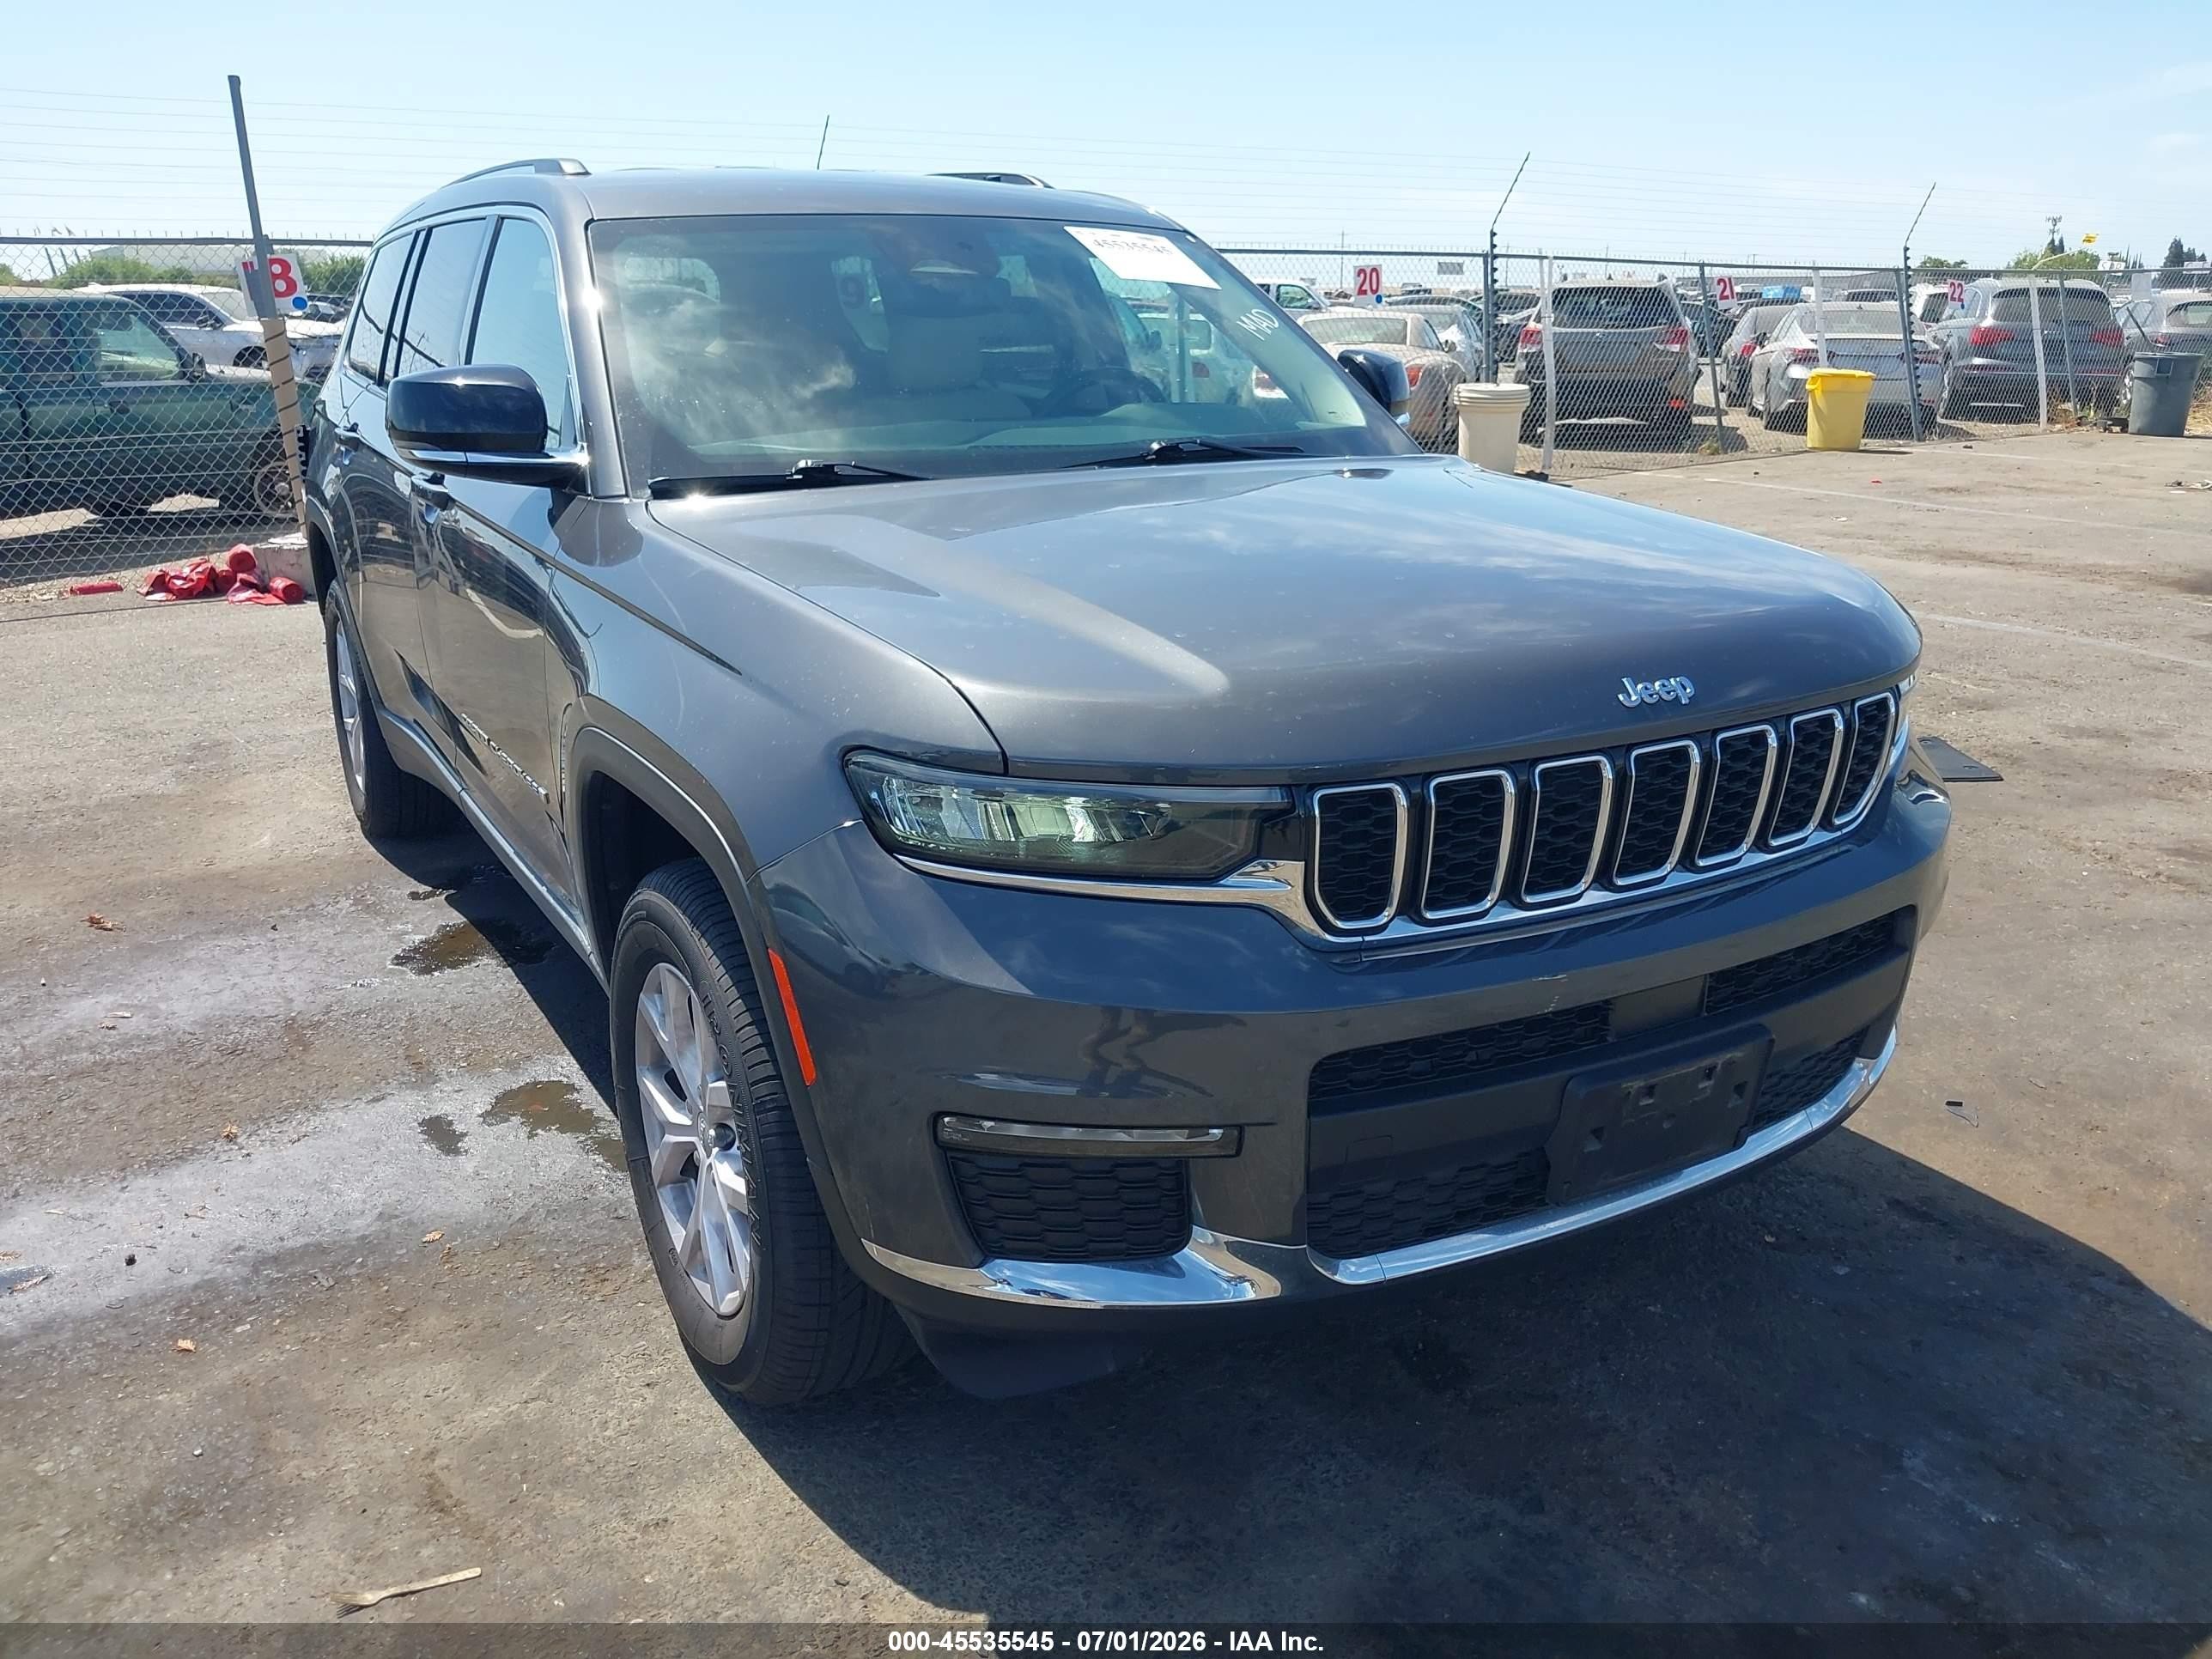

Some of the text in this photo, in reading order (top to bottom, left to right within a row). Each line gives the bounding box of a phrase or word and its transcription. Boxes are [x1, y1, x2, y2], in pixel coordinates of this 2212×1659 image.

[1357, 267, 1380, 296] 20
[1717, 277, 1735, 301] 21
[1949, 281, 1964, 303] 22
[1617, 676, 1695, 708] Jeep
